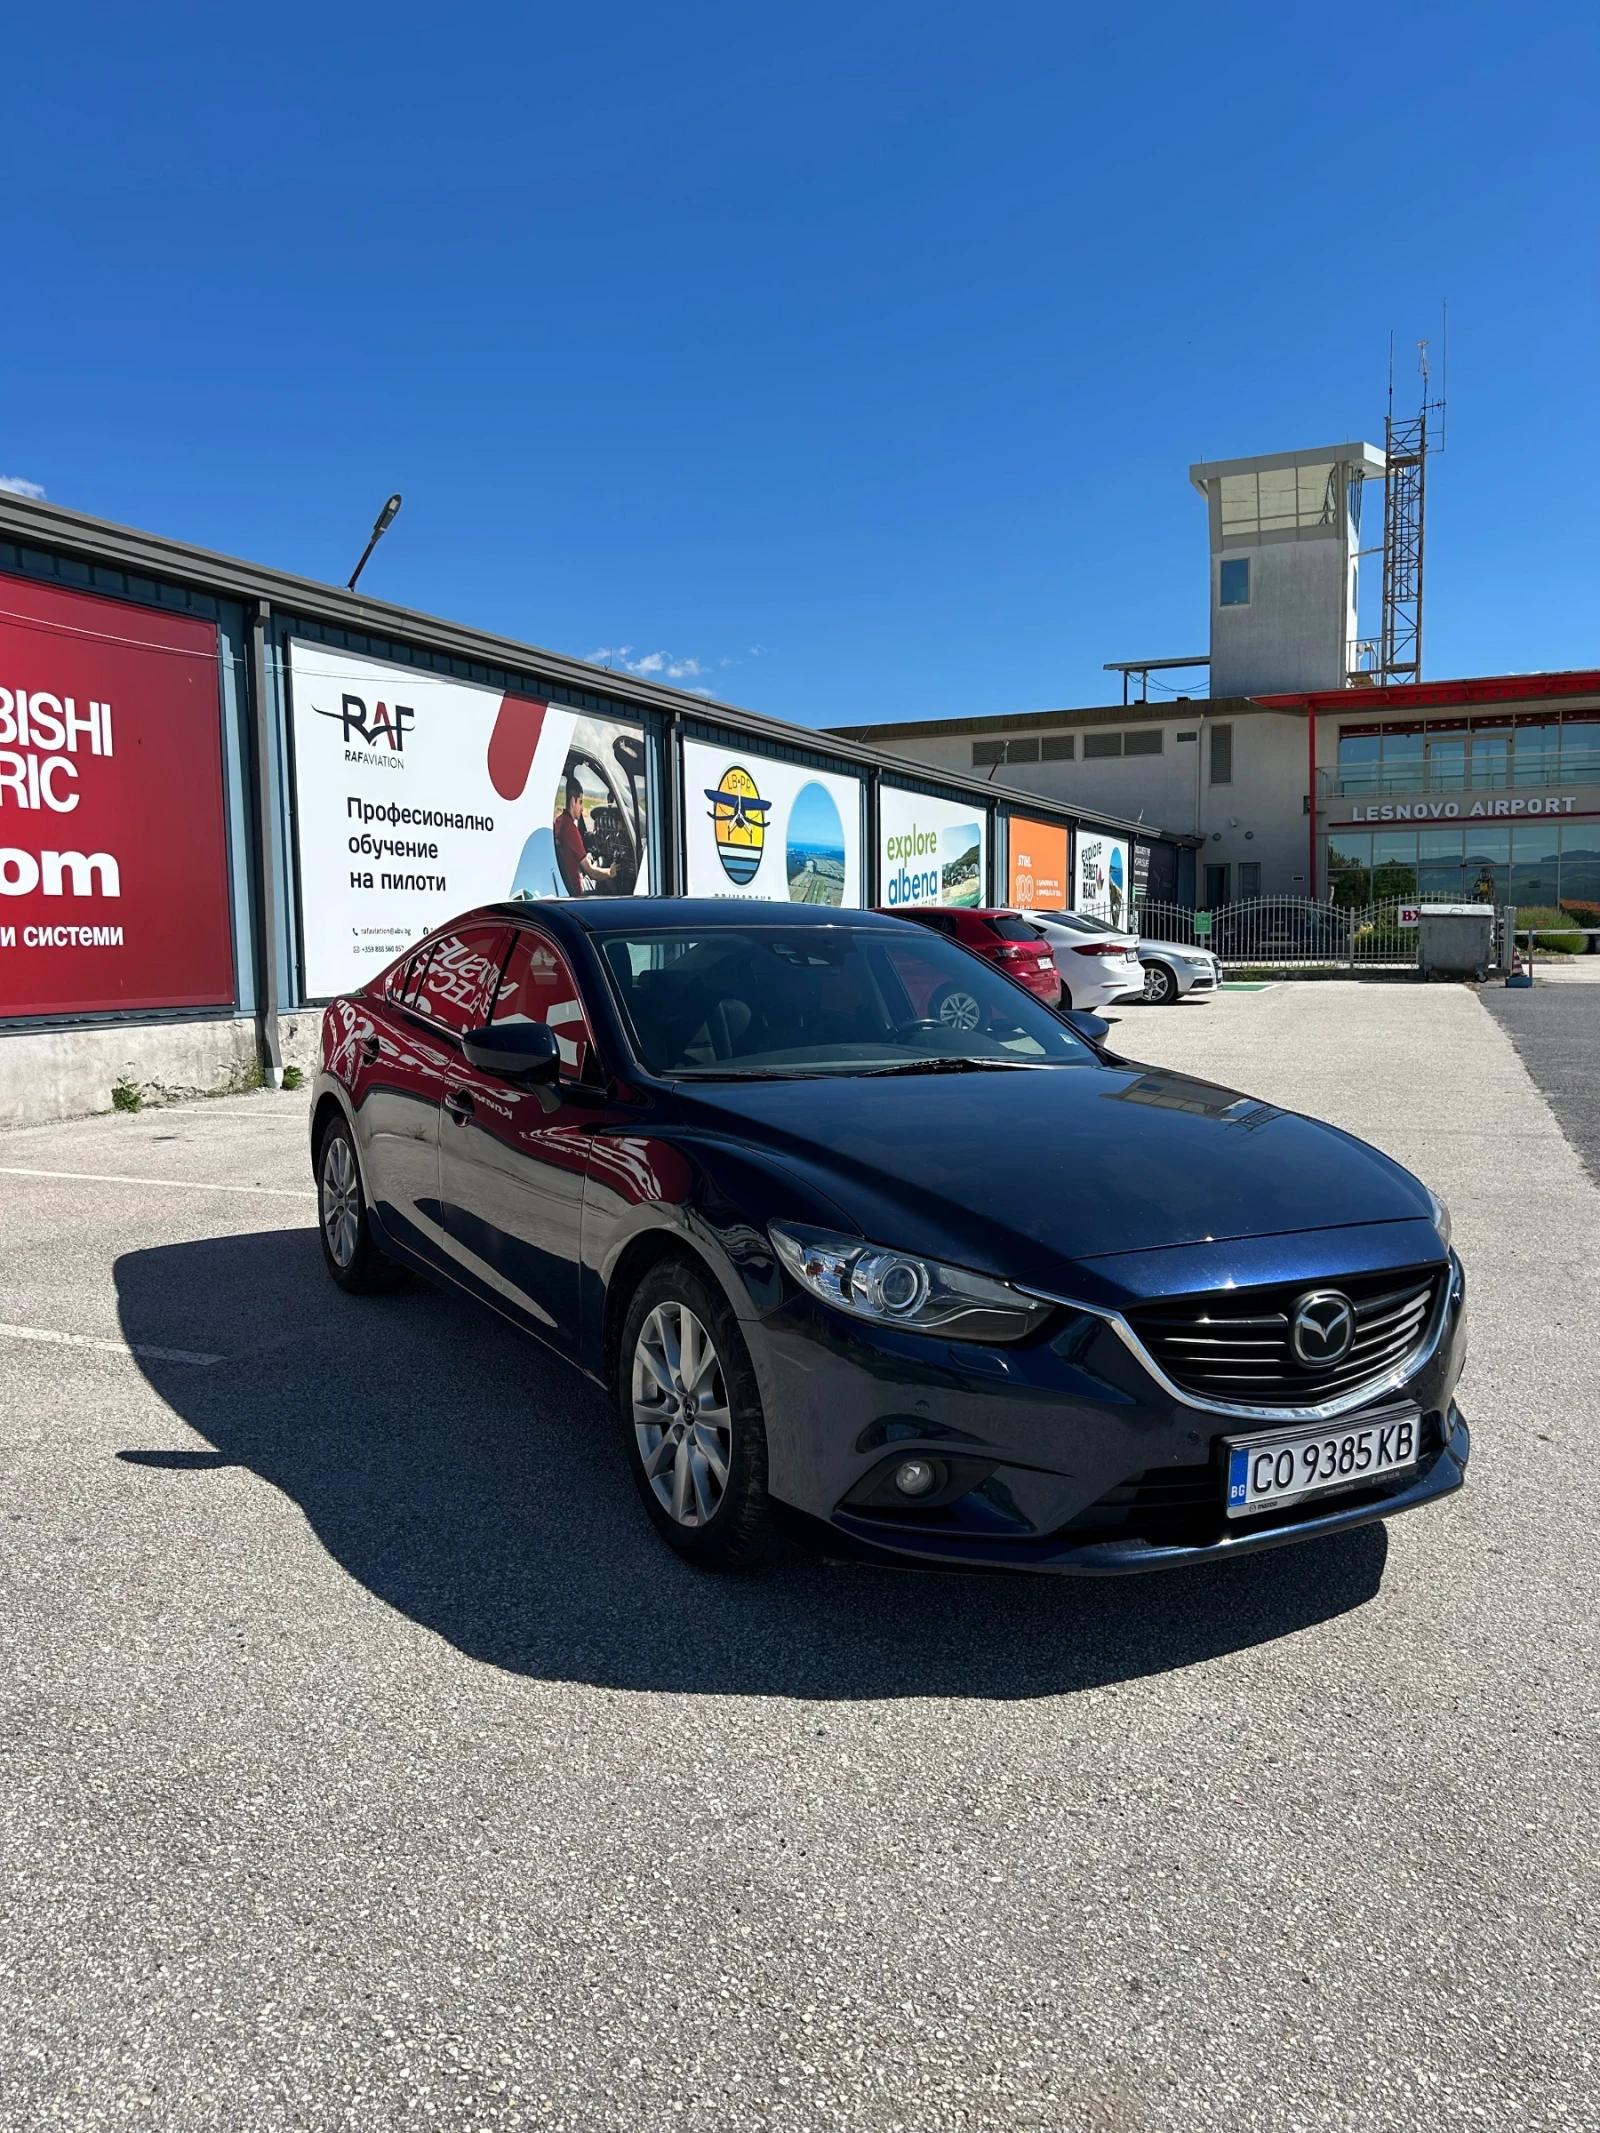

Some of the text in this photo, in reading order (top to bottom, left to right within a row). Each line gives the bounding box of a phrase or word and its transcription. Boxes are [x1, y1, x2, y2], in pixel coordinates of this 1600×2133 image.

[342, 693, 415, 751] RAF
[344, 749, 405, 769] RAFAVIATION
[347, 797, 494, 832] Професионално
[1352, 797, 1576, 821] LESNOVO AIRPORT
[348, 833, 438, 860] обучение
[887, 823, 937, 868] explore
[350, 871, 446, 891] на пилоти
[888, 868, 937, 906] albena
[1016, 874, 1034, 902] 100
[23, 926, 124, 947] системи
[1253, 1421, 1413, 1493] CO 9385 KB
[1231, 1484, 1246, 1498] BG
